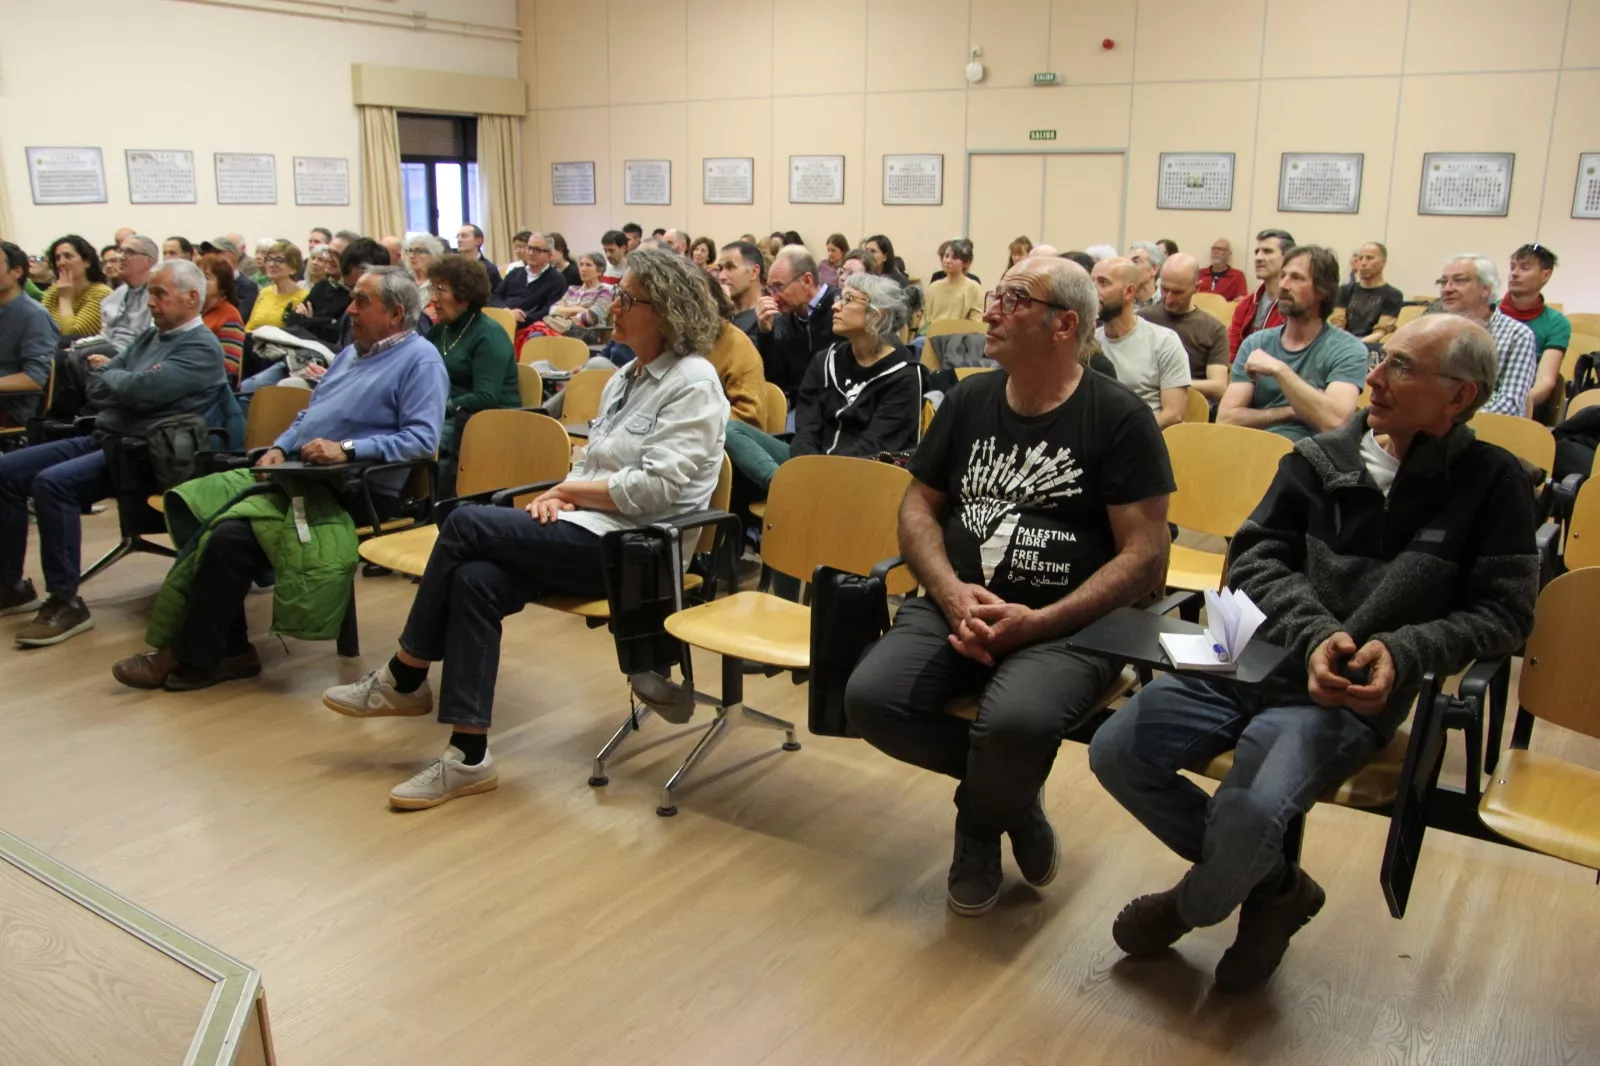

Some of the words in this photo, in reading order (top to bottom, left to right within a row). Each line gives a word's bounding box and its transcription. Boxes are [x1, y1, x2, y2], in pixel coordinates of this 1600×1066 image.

[1018, 526, 1077, 542] PALESTINA
[1015, 535, 1048, 548] LIBRE
[1012, 549, 1040, 561] FREE
[1010, 558, 1071, 573] PALESTINE
[1007, 570, 1026, 583] حرة
[1030, 574, 1069, 587] فلسطين
